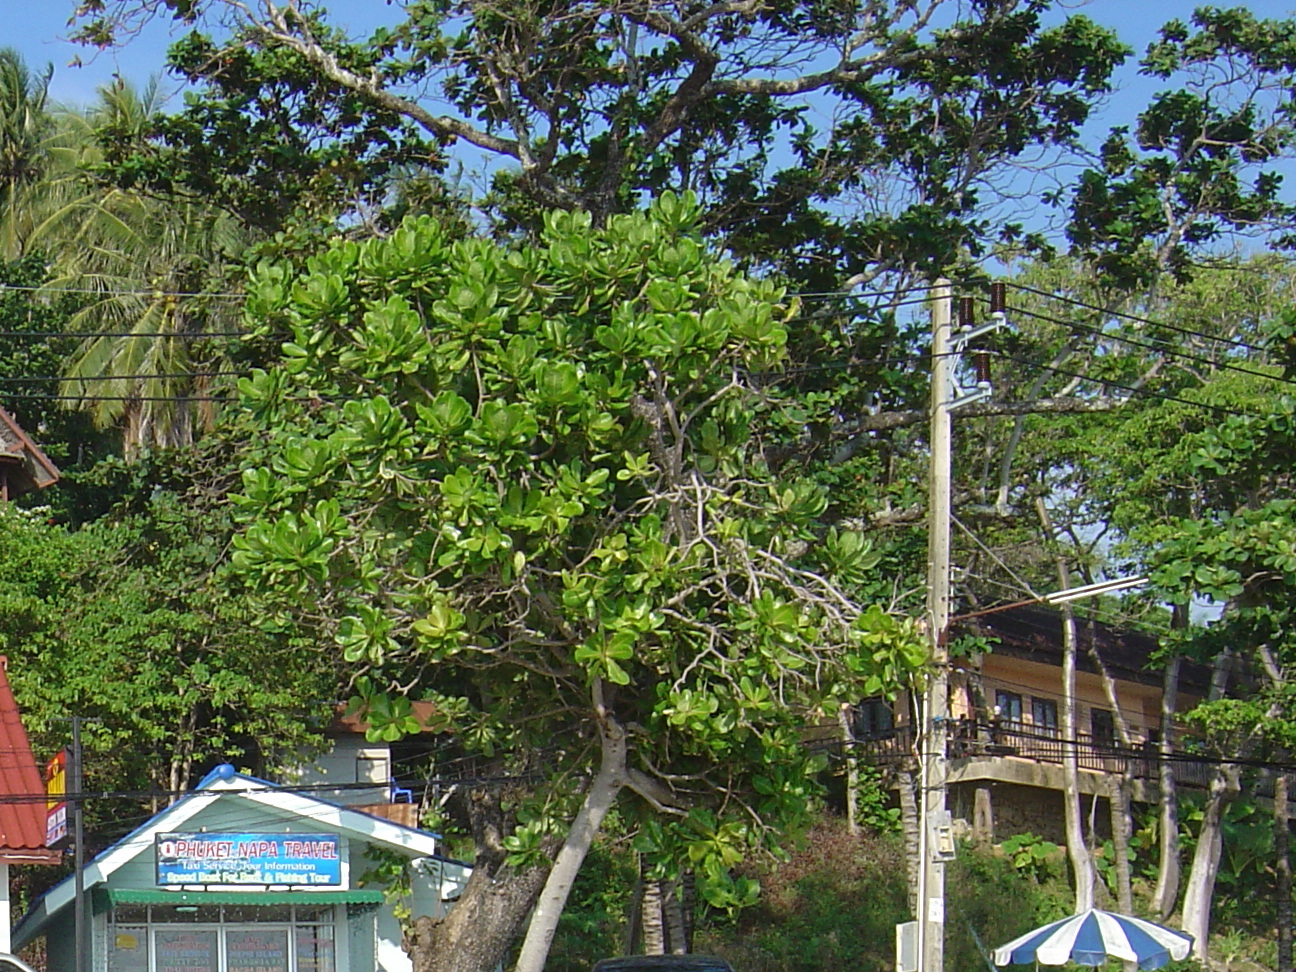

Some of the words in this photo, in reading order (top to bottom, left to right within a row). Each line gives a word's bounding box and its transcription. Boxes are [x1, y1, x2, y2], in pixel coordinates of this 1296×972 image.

[175, 841, 233, 858] PHUKET
[238, 841, 279, 858] NAPA
[284, 841, 338, 859] TRAVEL
[264, 862, 316, 870] Information
[167, 872, 196, 883] Speed
[309, 873, 331, 883] Tour
